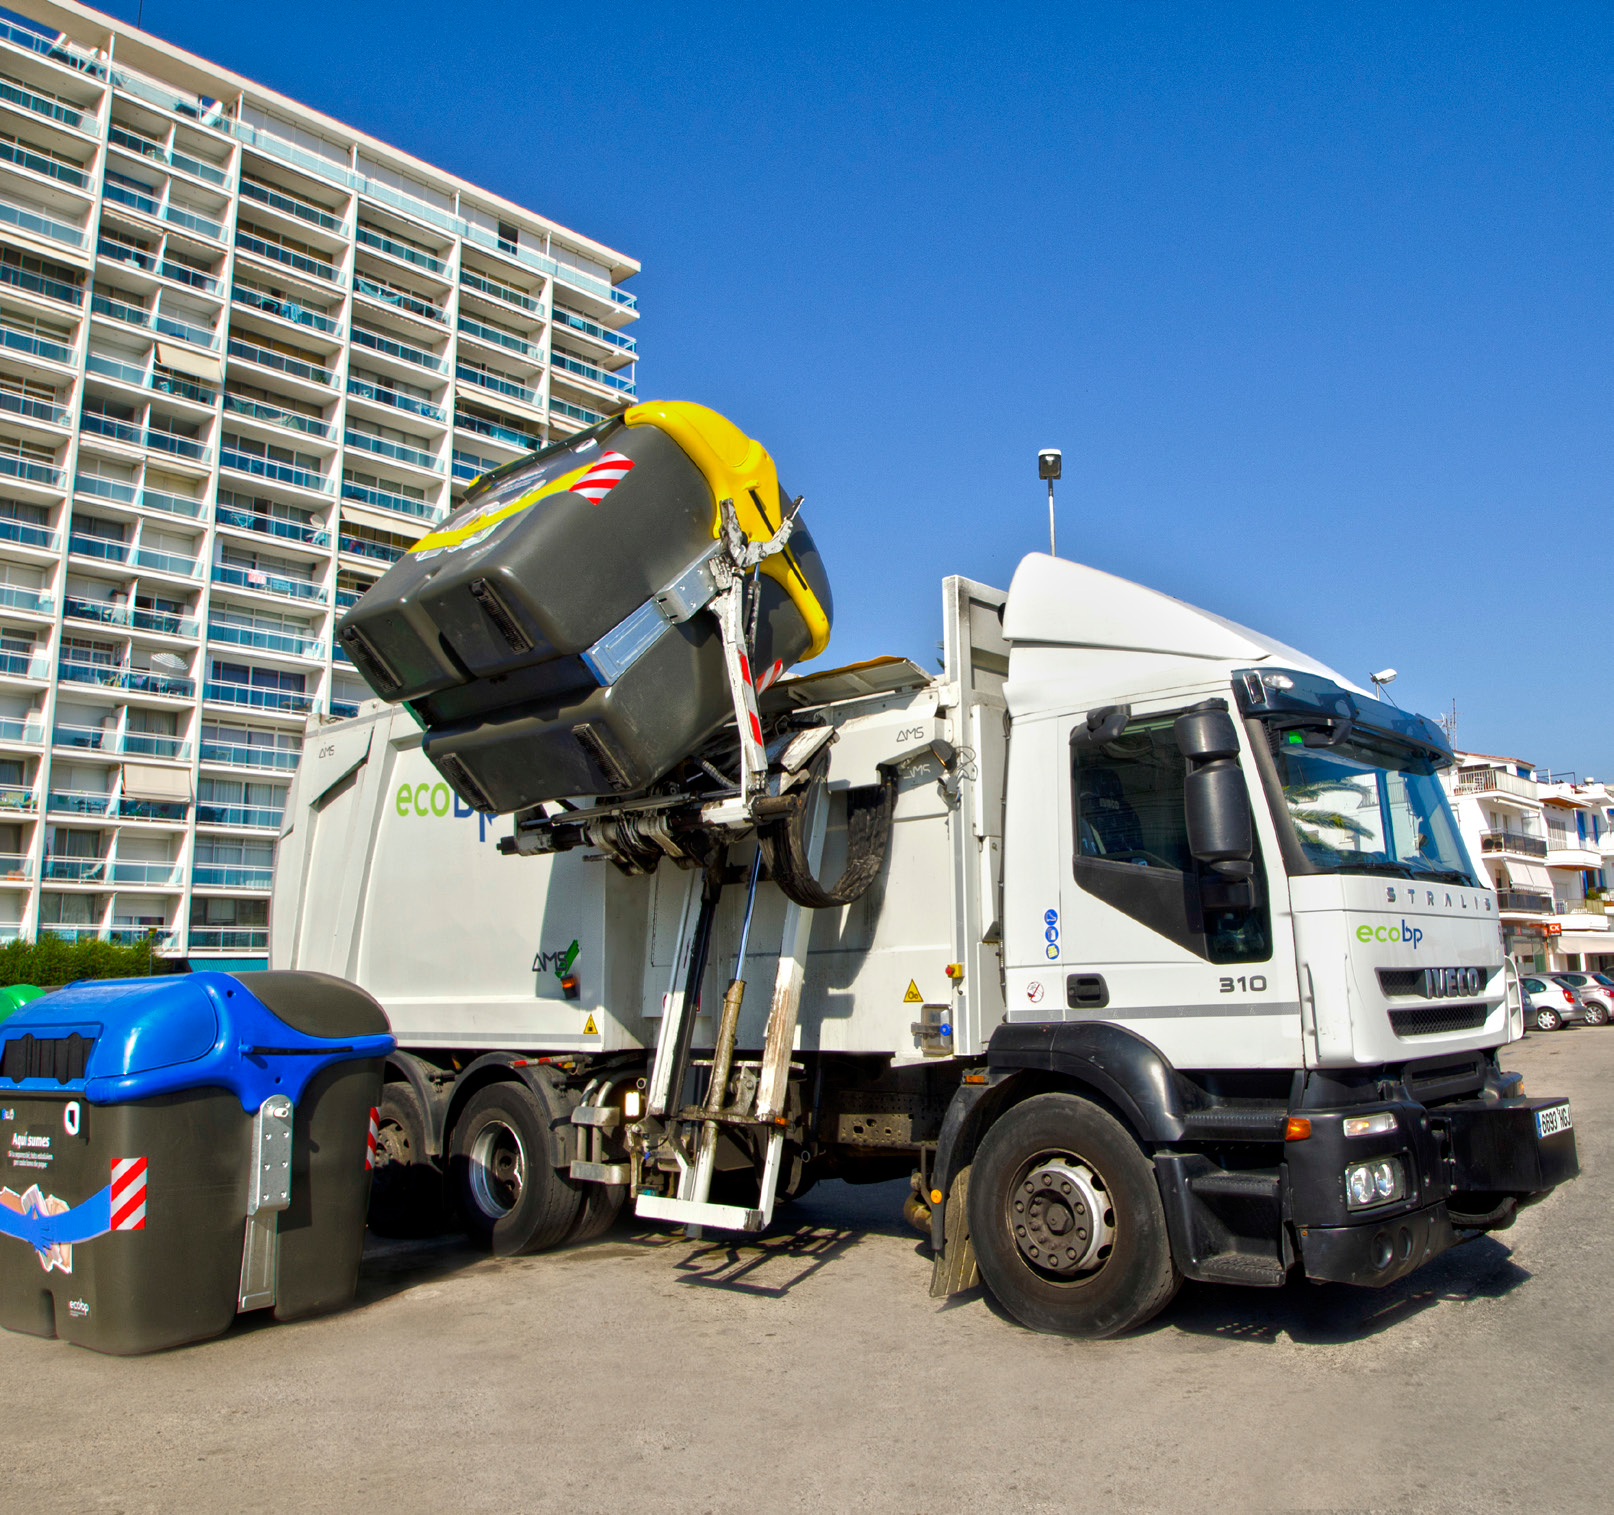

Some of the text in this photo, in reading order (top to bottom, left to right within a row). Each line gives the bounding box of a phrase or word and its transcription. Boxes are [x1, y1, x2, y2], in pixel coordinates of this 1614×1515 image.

[896, 726, 924, 742] AMS
[1386, 886, 1491, 911] STRALIS
[1356, 919, 1423, 949] ecobp
[532, 950, 568, 972] AMS
[1219, 975, 1267, 993] 310
[1424, 967, 1480, 999] IVECO
